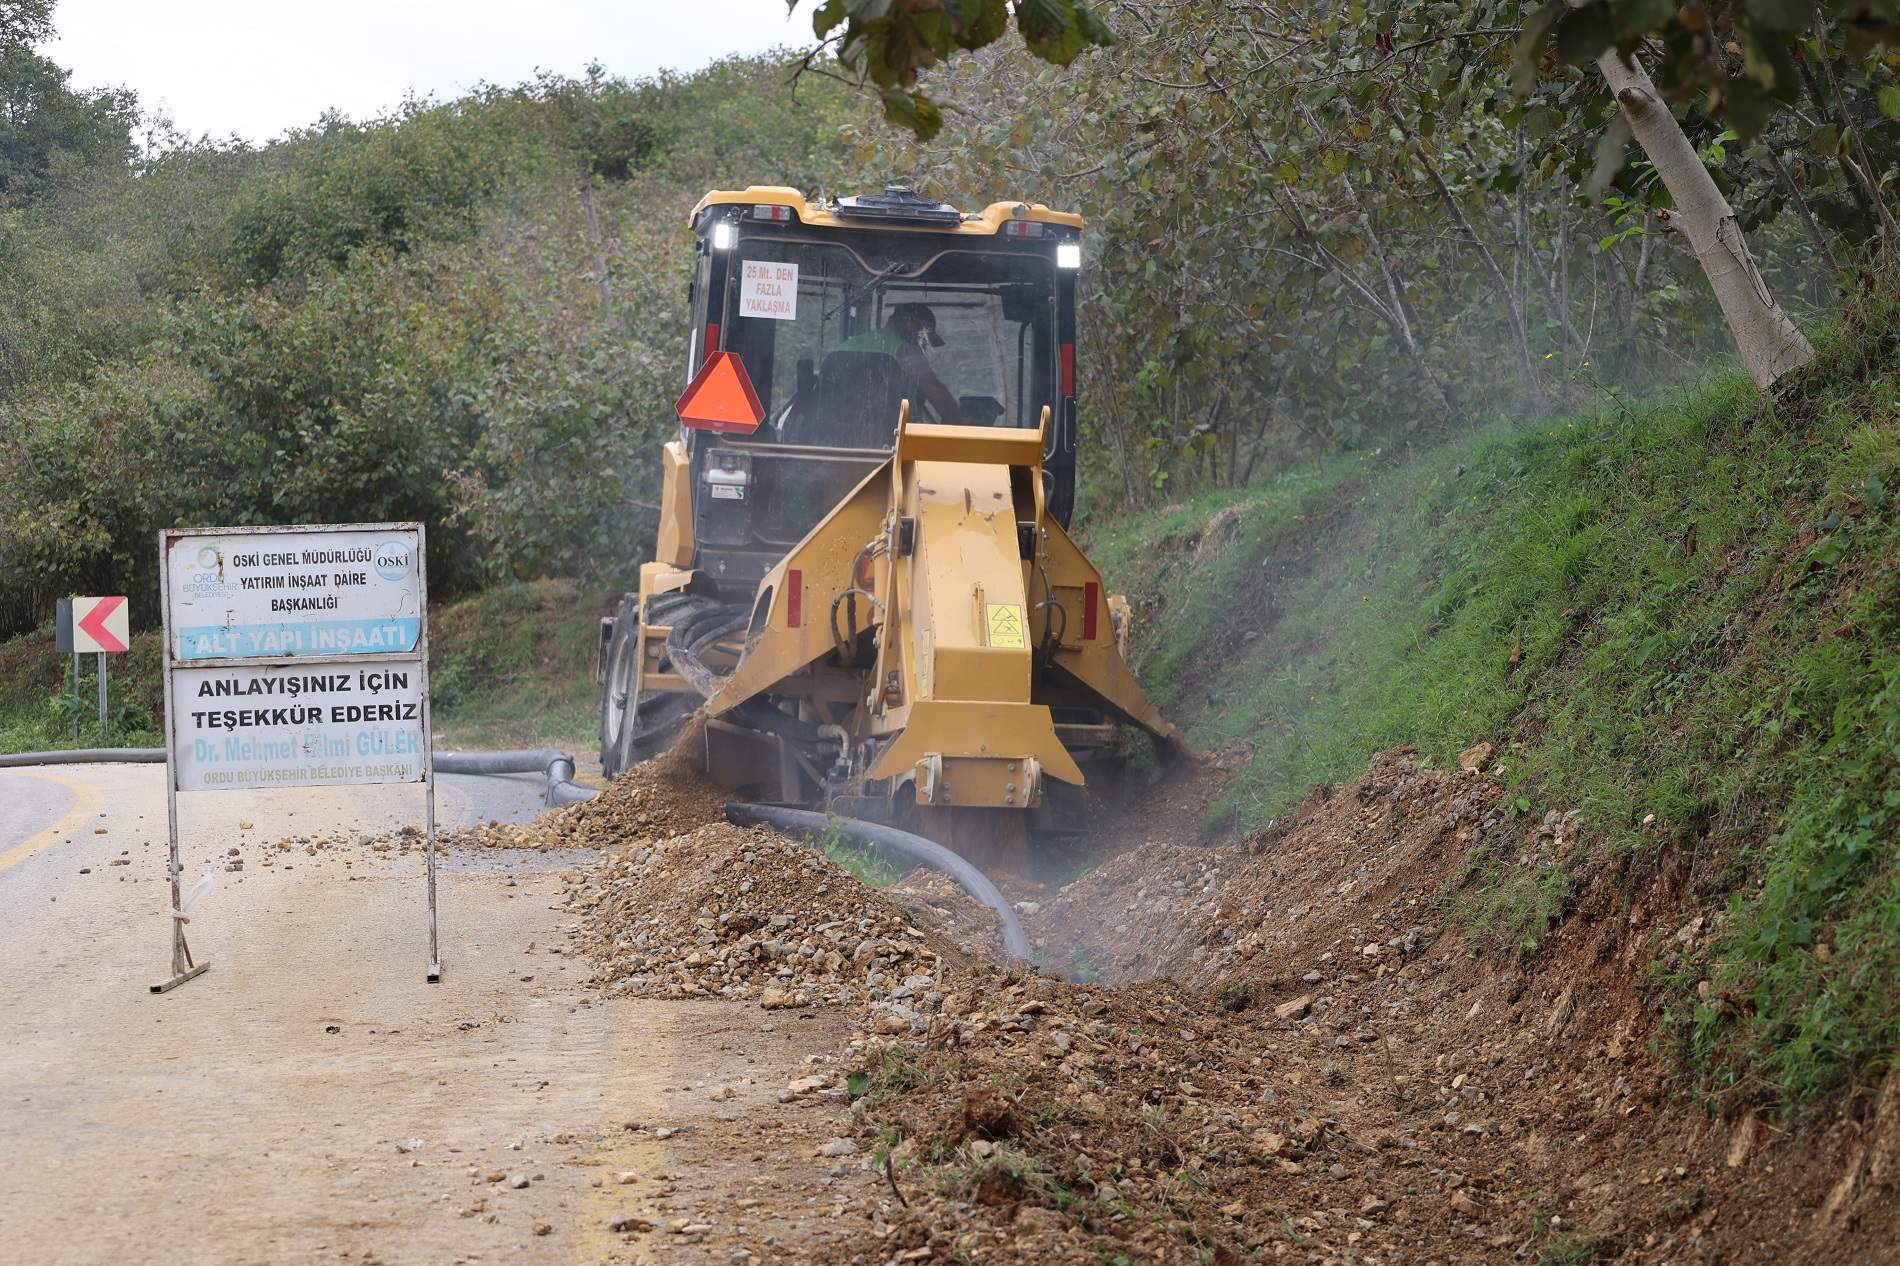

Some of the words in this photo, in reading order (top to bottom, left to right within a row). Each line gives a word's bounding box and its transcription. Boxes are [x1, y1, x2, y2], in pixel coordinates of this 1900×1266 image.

[747, 265, 756, 278] 25
[776, 268, 793, 280] DEN
[756, 282, 782, 296] FAZLA
[746, 298, 791, 315] YAKLAŞMA
[233, 552, 260, 567] OSKİ
[262, 552, 299, 566] GENEL
[302, 548, 372, 565] MÜDÜRLÜĞÜ
[240, 576, 285, 590] YATIRIM
[288, 573, 328, 590] İNŞAAT
[334, 570, 366, 586] DAİRE
[272, 594, 338, 614] BAŞKANLIĞI
[196, 633, 241, 654] ALT
[248, 629, 302, 651] YAPI
[311, 624, 406, 652] İNŞAATI
[198, 674, 351, 698] ANLAYIŞINIZ
[359, 670, 408, 694] İÇİN
[192, 704, 323, 732] TEŞEKKÜR
[332, 700, 418, 724] EDERİZ
[194, 738, 218, 763] Dr.
[224, 734, 298, 762] Mehmet
[356, 726, 420, 756] GÜLER
[204, 771, 234, 784] ORDU
